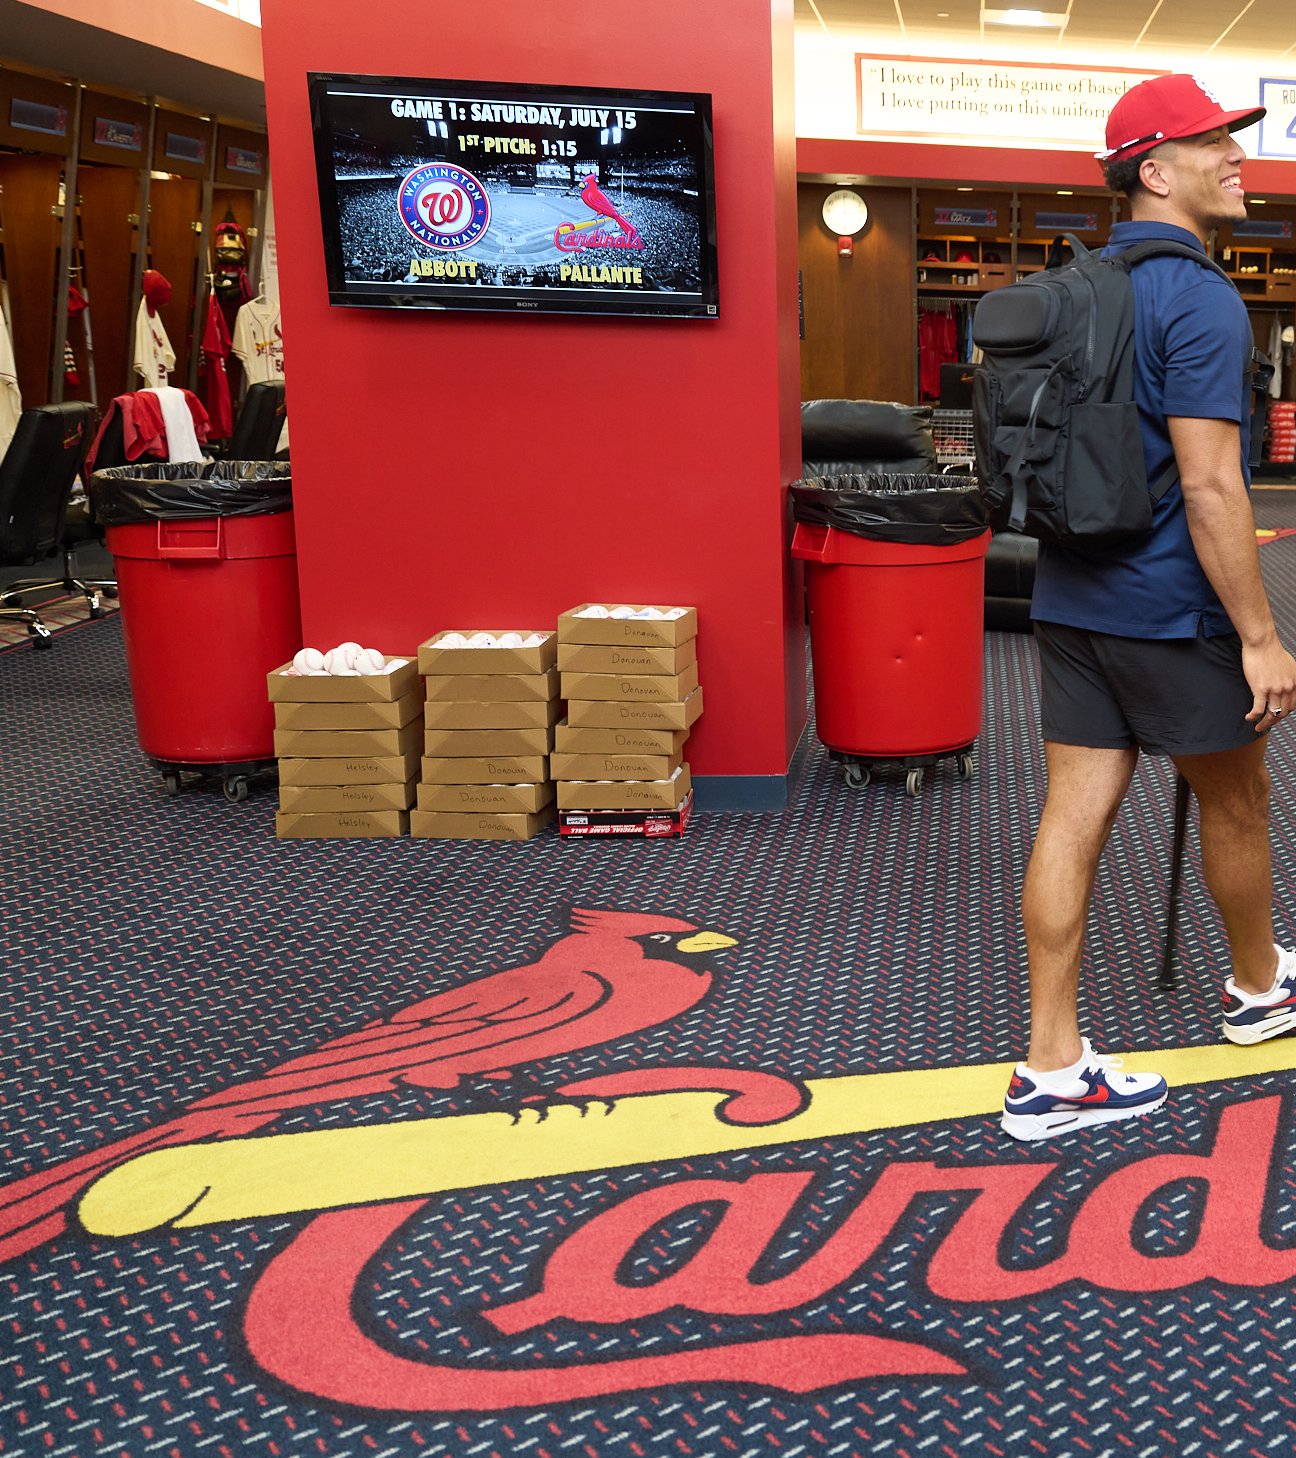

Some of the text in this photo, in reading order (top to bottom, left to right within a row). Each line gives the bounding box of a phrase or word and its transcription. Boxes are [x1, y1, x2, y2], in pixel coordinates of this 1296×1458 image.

[891, 67, 924, 85] love
[930, 73, 945, 86] to
[950, 71, 982, 93] play
[988, 73, 1016, 90] this
[1021, 80, 1063, 95] game
[1068, 77, 1085, 93] of
[881, 92, 886, 107] I
[892, 93, 924, 109] love
[930, 97, 988, 116] putting
[993, 101, 1014, 113] on
[1018, 99, 1047, 114] this
[390, 99, 637, 129] GAME 1: SATURDAY, JULY 15
[484, 136, 536, 155] PITCH:
[542, 139, 577, 157] 1:15
[404, 167, 482, 200] WASHINGTON
[421, 188, 463, 226] W
[410, 219, 481, 246] NATIONALS
[554, 221, 644, 252] Cardinals
[409, 258, 478, 278] ABBOTT
[560, 264, 643, 284] PALLANTE
[611, 653, 651, 665] Donovan
[619, 707, 666, 720] Donovan
[615, 734, 661, 748] Donovan
[346, 763, 379, 773] Helsley
[487, 763, 526, 774] Donovan
[604, 760, 649, 772] Donovan
[342, 792, 374, 802] Helsley
[460, 792, 506, 804] Donovan
[338, 819, 370, 829] Helsley
[478, 819, 515, 833] Donovan
